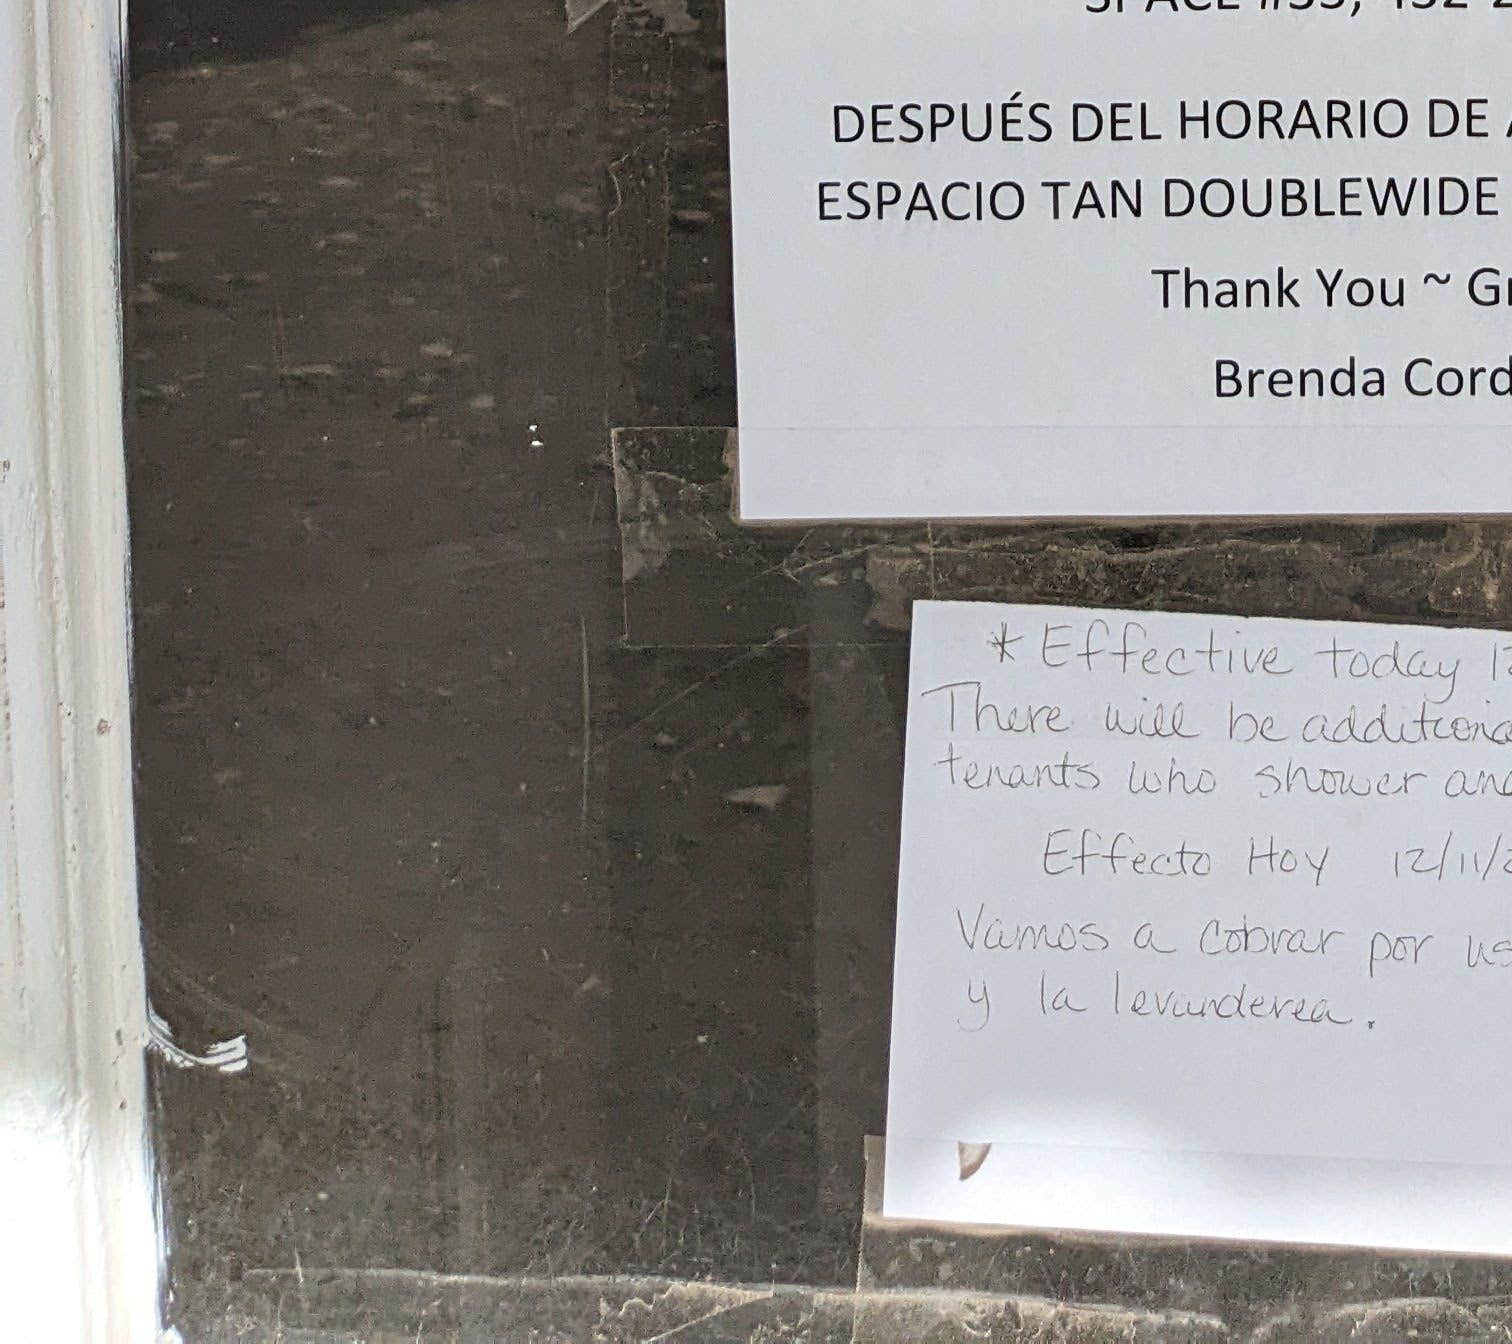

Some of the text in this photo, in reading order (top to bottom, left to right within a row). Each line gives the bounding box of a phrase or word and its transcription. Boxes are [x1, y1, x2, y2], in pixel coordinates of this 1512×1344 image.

[833, 90, 1053, 144] DESPUÉS
[1072, 101, 1163, 143] DEL
[1179, 98, 1409, 140] HORARIO
[1428, 98, 1489, 138] DE
[818, 180, 1025, 222] ESPACIO
[1040, 178, 1142, 220] TAN
[1164, 176, 1499, 218] DOUBLEWIDE
[1150, 265, 1301, 309] Thank
[1315, 268, 1405, 308] You
[1215, 355, 1385, 398] Brenda
[1044, 618, 1294, 675] Effective
[1315, 634, 1460, 704] today
[921, 681, 1070, 734] There
[1105, 697, 1200, 738] will
[1228, 701, 1288, 743] be
[934, 743, 1100, 789] tenants
[1129, 757, 1216, 795] who
[1255, 760, 1425, 799] shower
[1044, 828, 1212, 876] Effecto
[1247, 835, 1329, 886] Hoy
[957, 903, 1108, 952] Vamos
[1134, 923, 1176, 954] a
[1368, 930, 1435, 977] por
[954, 980, 990, 1033] y
[1040, 972, 1086, 1013] la
